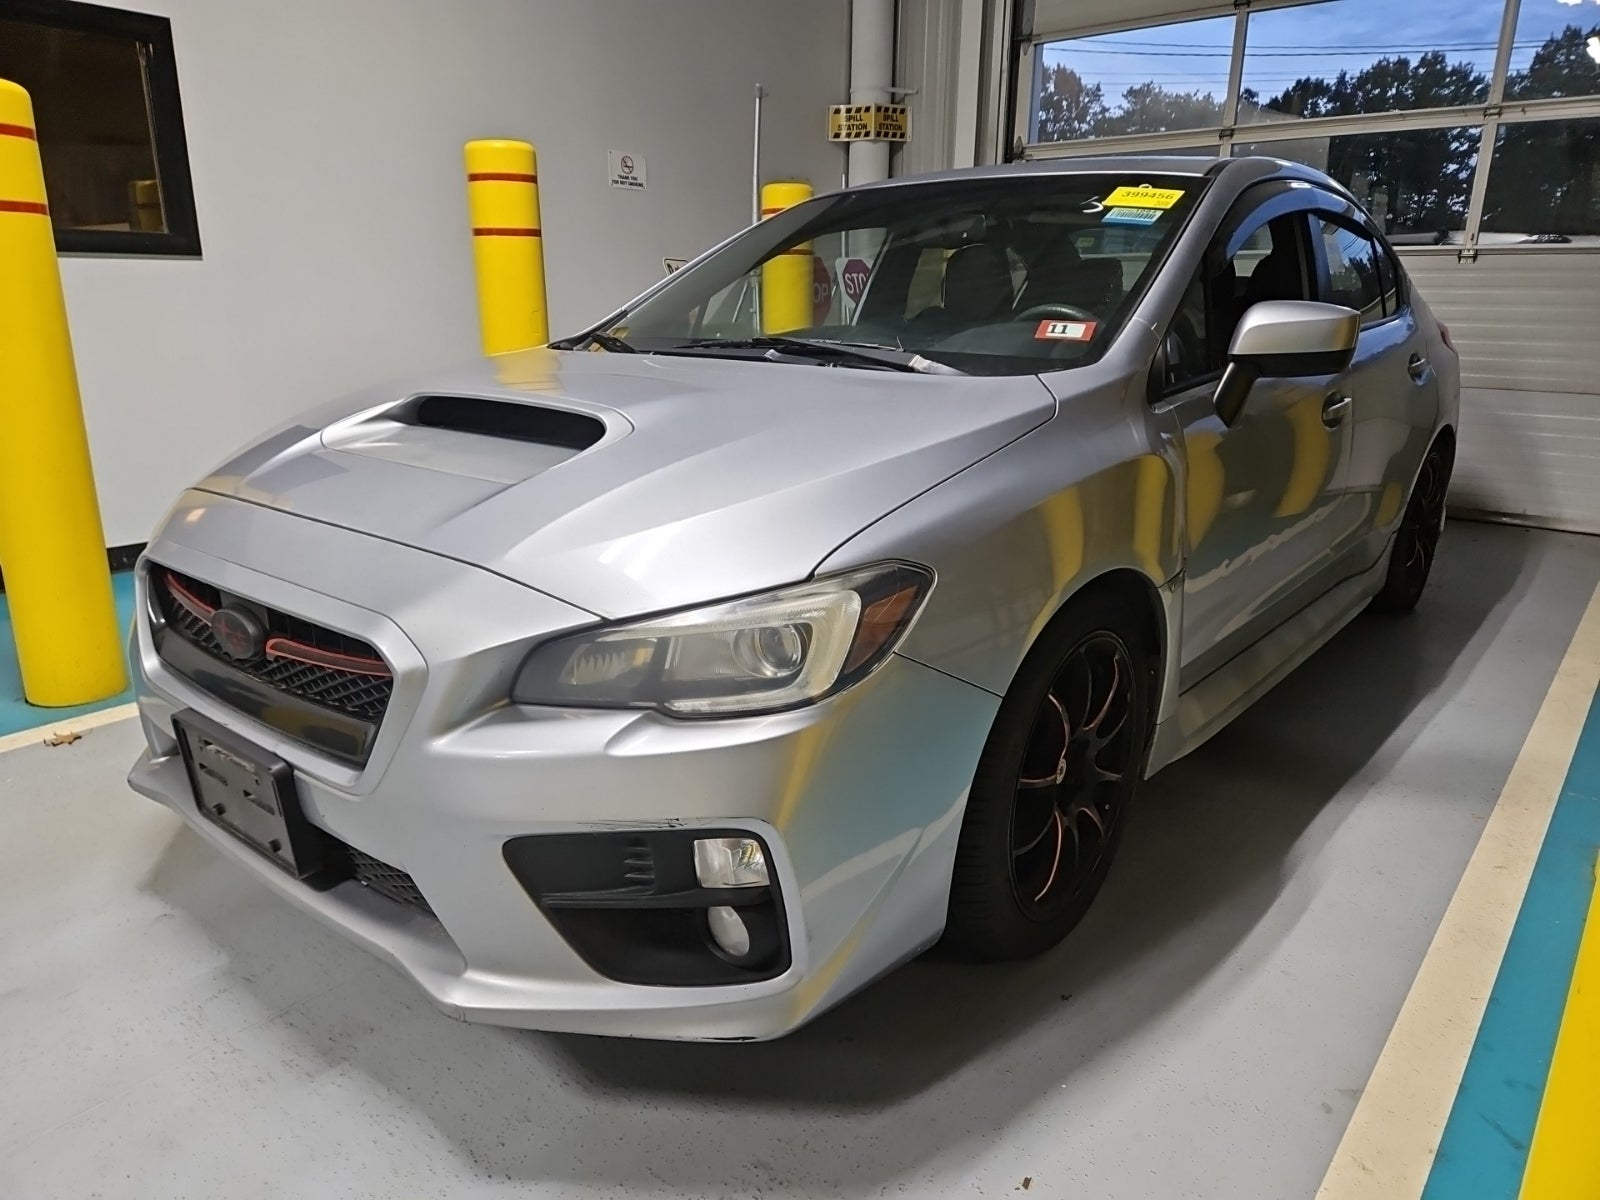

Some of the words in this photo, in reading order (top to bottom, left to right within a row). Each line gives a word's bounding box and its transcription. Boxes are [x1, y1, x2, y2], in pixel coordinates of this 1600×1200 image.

[845, 114, 863, 122] SPILL
[883, 113, 899, 122] SPILL
[838, 122, 868, 131] STATION
[878, 123, 903, 131] STATION
[1121, 190, 1175, 200] 399456
[844, 272, 868, 294] STO
[1047, 323, 1069, 335] 11
